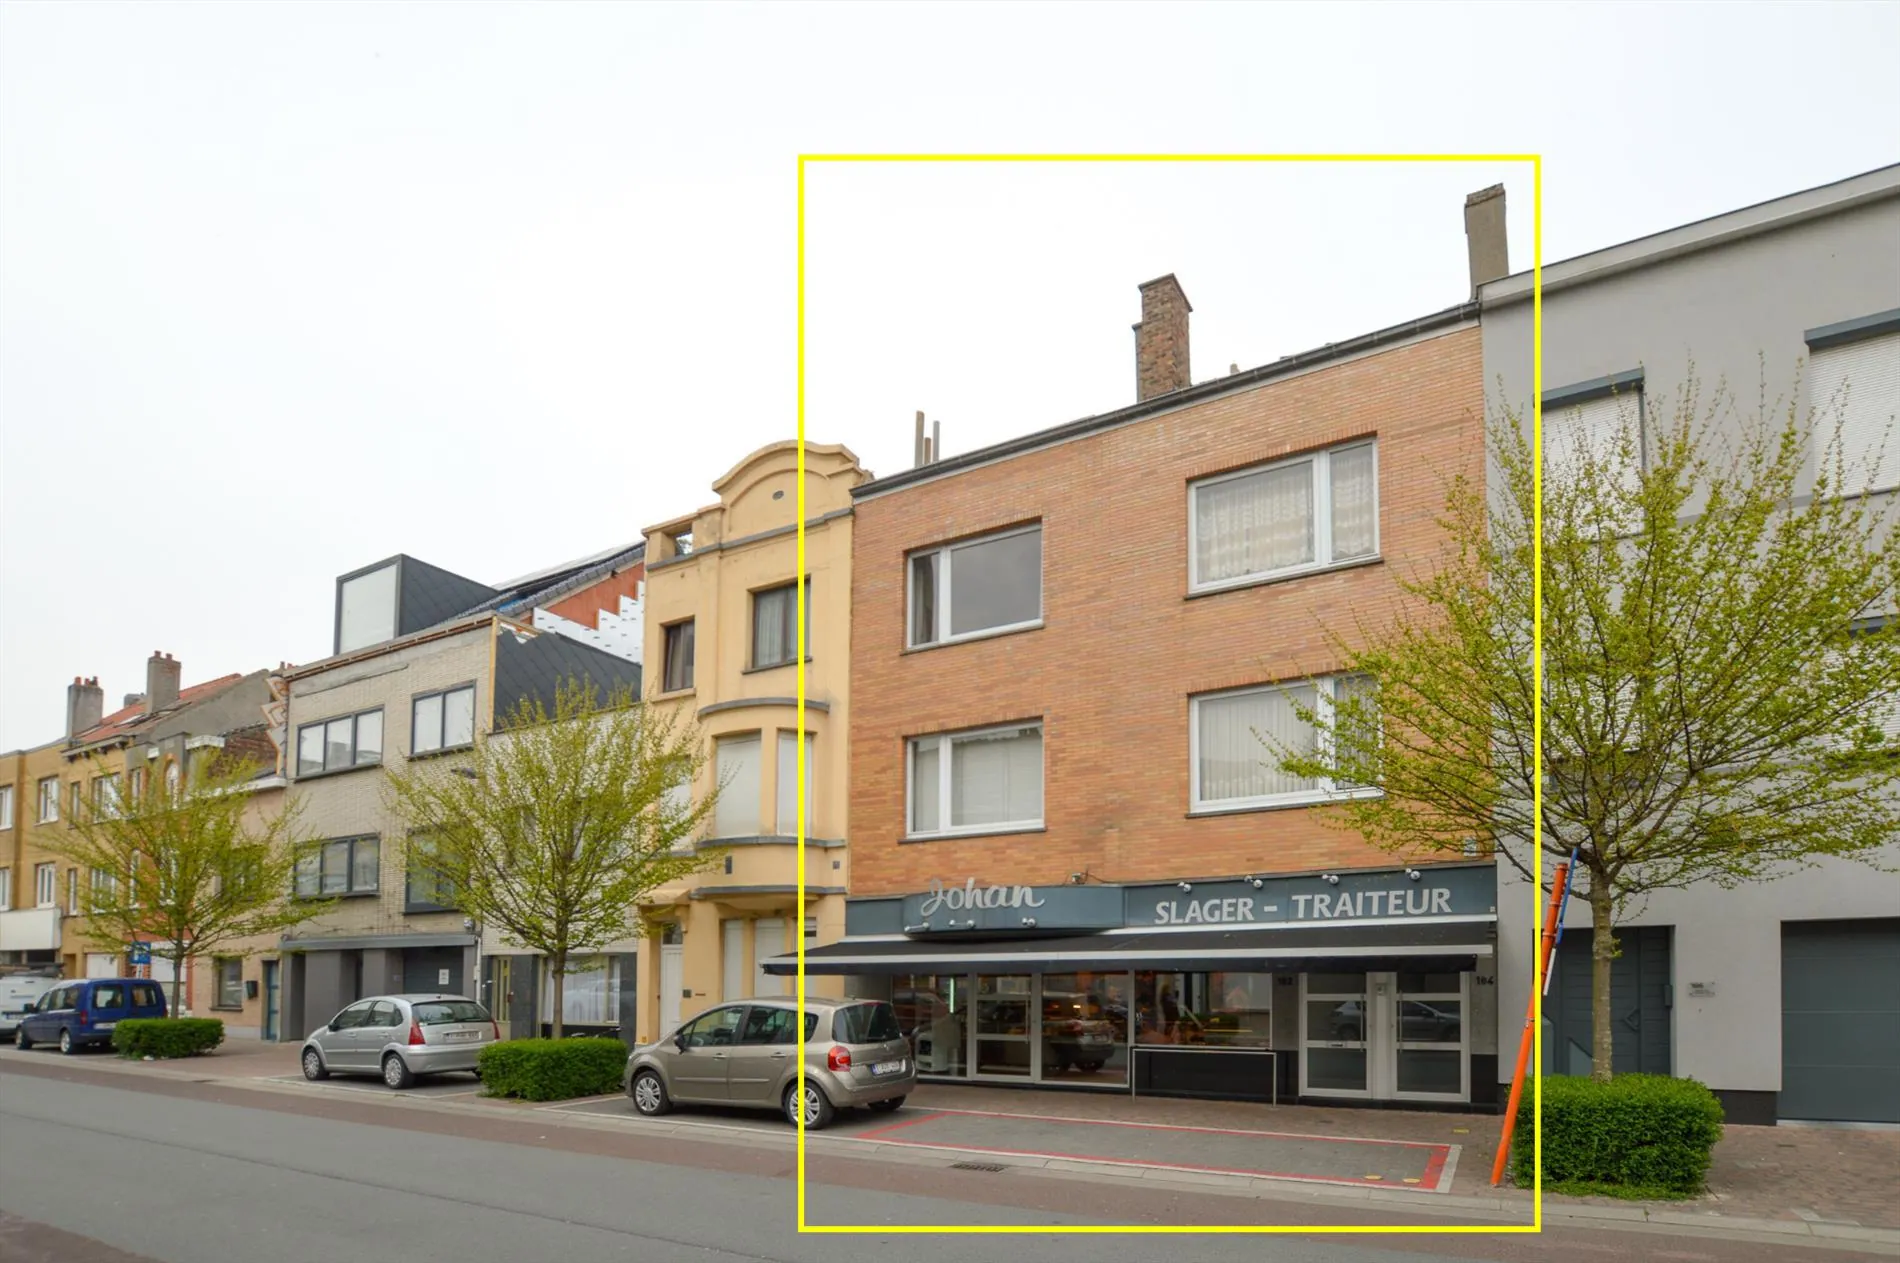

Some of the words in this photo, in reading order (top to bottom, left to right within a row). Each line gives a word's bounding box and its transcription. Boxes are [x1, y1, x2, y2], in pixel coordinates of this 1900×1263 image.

[920, 877, 1045, 917] Johan
[1154, 897, 1255, 924] SLAGER
[1291, 888, 1452, 919] TRAITEUR
